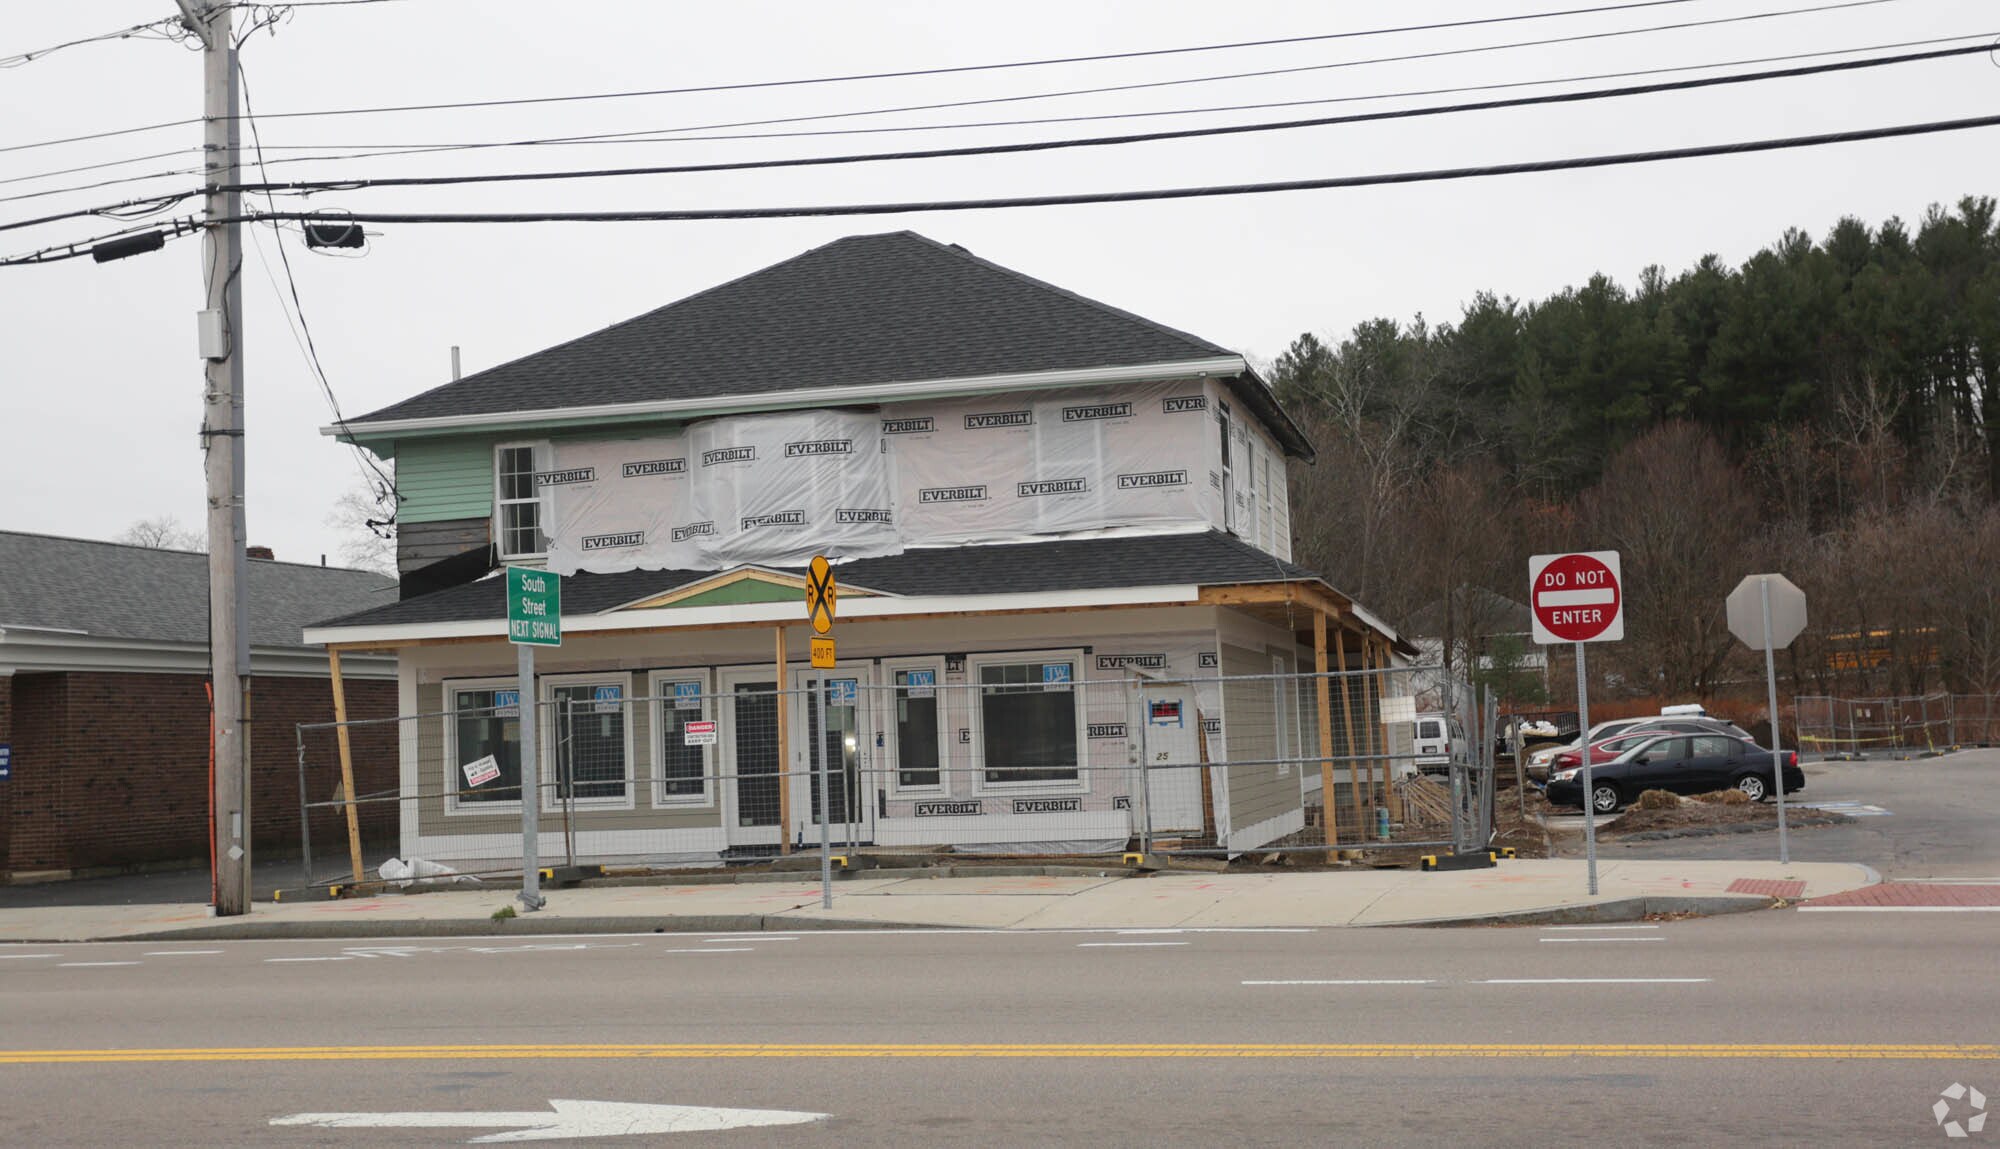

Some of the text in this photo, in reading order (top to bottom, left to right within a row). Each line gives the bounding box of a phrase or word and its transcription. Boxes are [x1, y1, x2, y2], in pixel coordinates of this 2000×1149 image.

[1065, 404, 1130, 420] EVERBILT
[967, 413, 1031, 427] EVERBILT
[787, 441, 849, 456] EVERBILT
[703, 448, 752, 466] EVERBILT
[625, 460, 683, 476] EVERBILT
[536, 469, 592, 485] EVERBILT
[1121, 472, 1184, 487] EVERBILT
[922, 487, 984, 502] EVERBILT
[1020, 480, 1083, 495] EVERBILT
[743, 512, 801, 530] ERBILT
[584, 534, 642, 549] EVERBILT
[521, 574, 546, 593] South
[1545, 570, 1606, 587] DO NOT
[522, 597, 546, 616] Street
[1552, 609, 1602, 625] ENTER
[511, 620, 558, 640] NEXT SIGNAL
[813, 647, 833, 659] 400 FT
[1088, 725, 1125, 737] RBILT
[1156, 751, 1169, 761] 25
[917, 803, 979, 816] EVERBILT
[1016, 801, 1078, 813] EVERBILT
